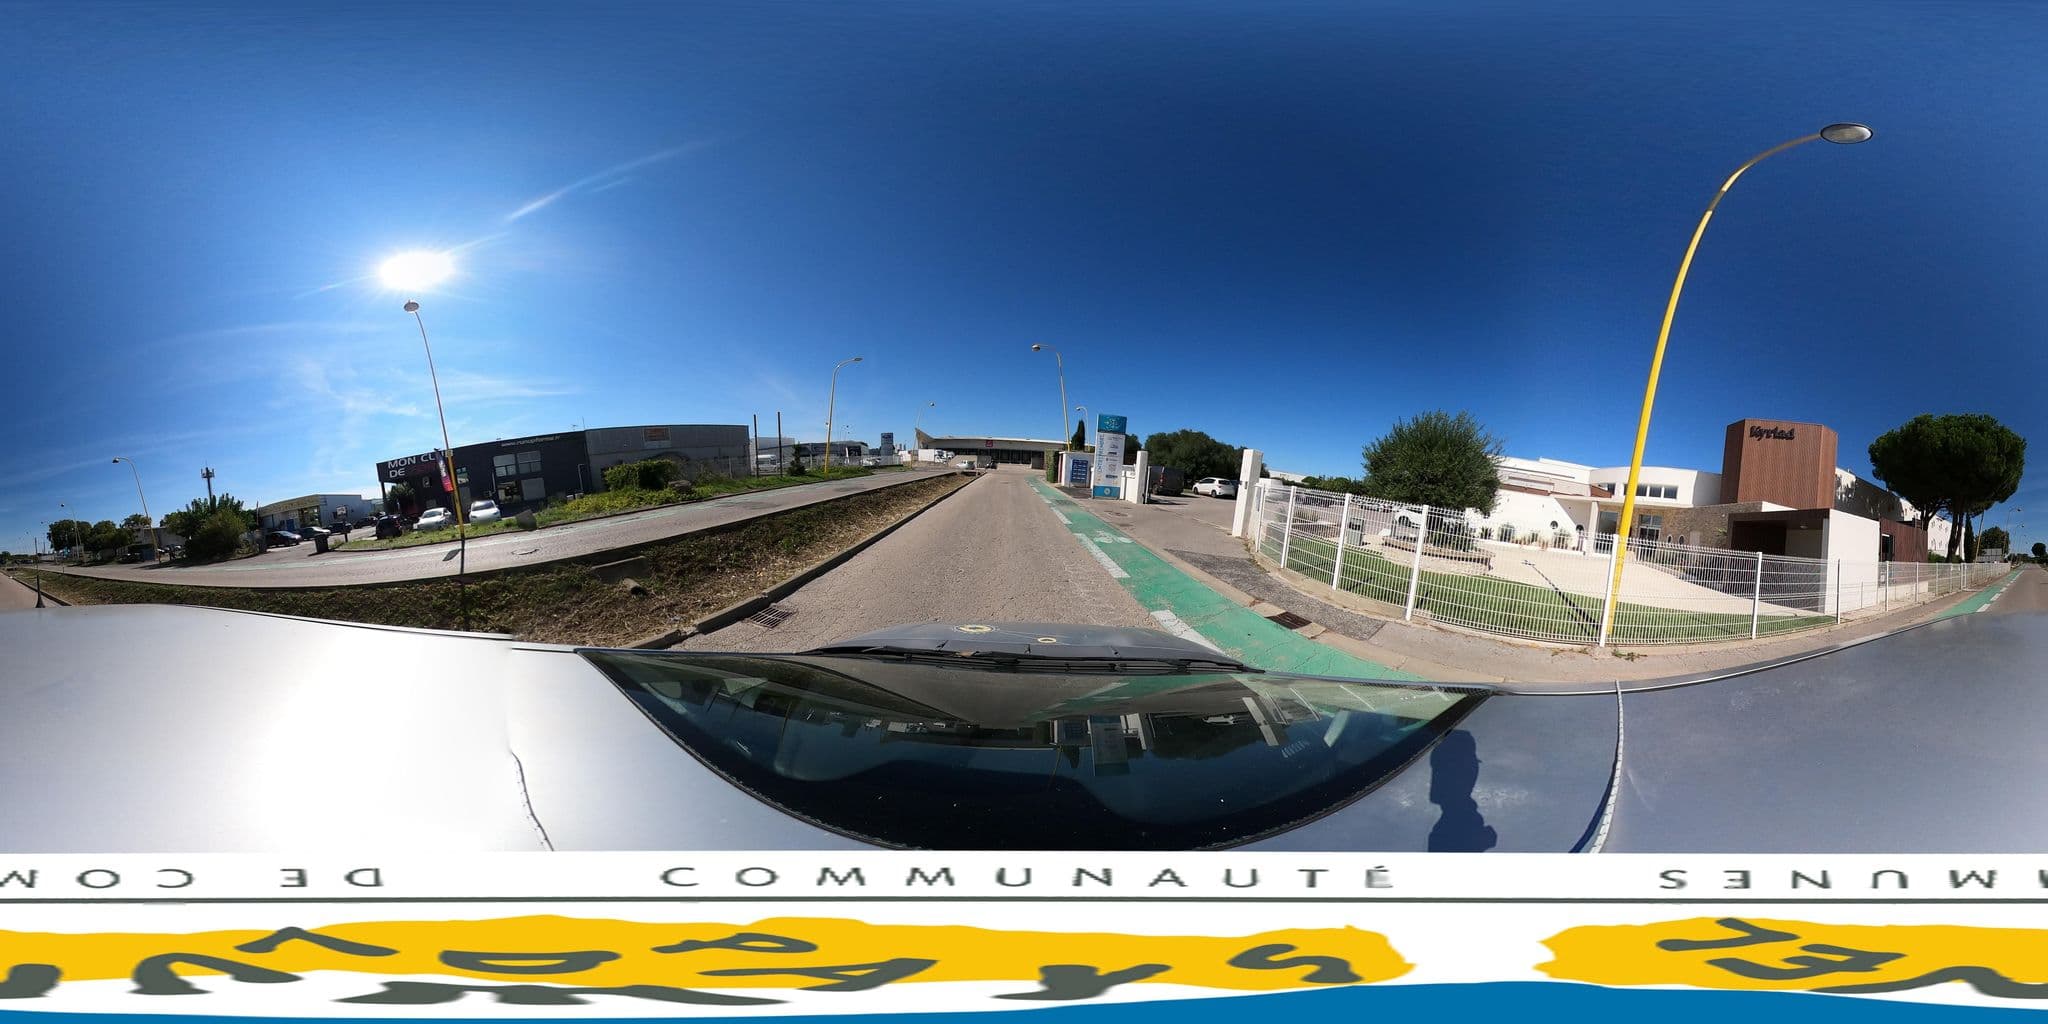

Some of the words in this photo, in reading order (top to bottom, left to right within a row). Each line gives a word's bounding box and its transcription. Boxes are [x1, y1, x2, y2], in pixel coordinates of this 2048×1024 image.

[1750, 426, 1795, 441] Kyriad
[388, 456, 416, 469] MON
[389, 468, 406, 478] DE
